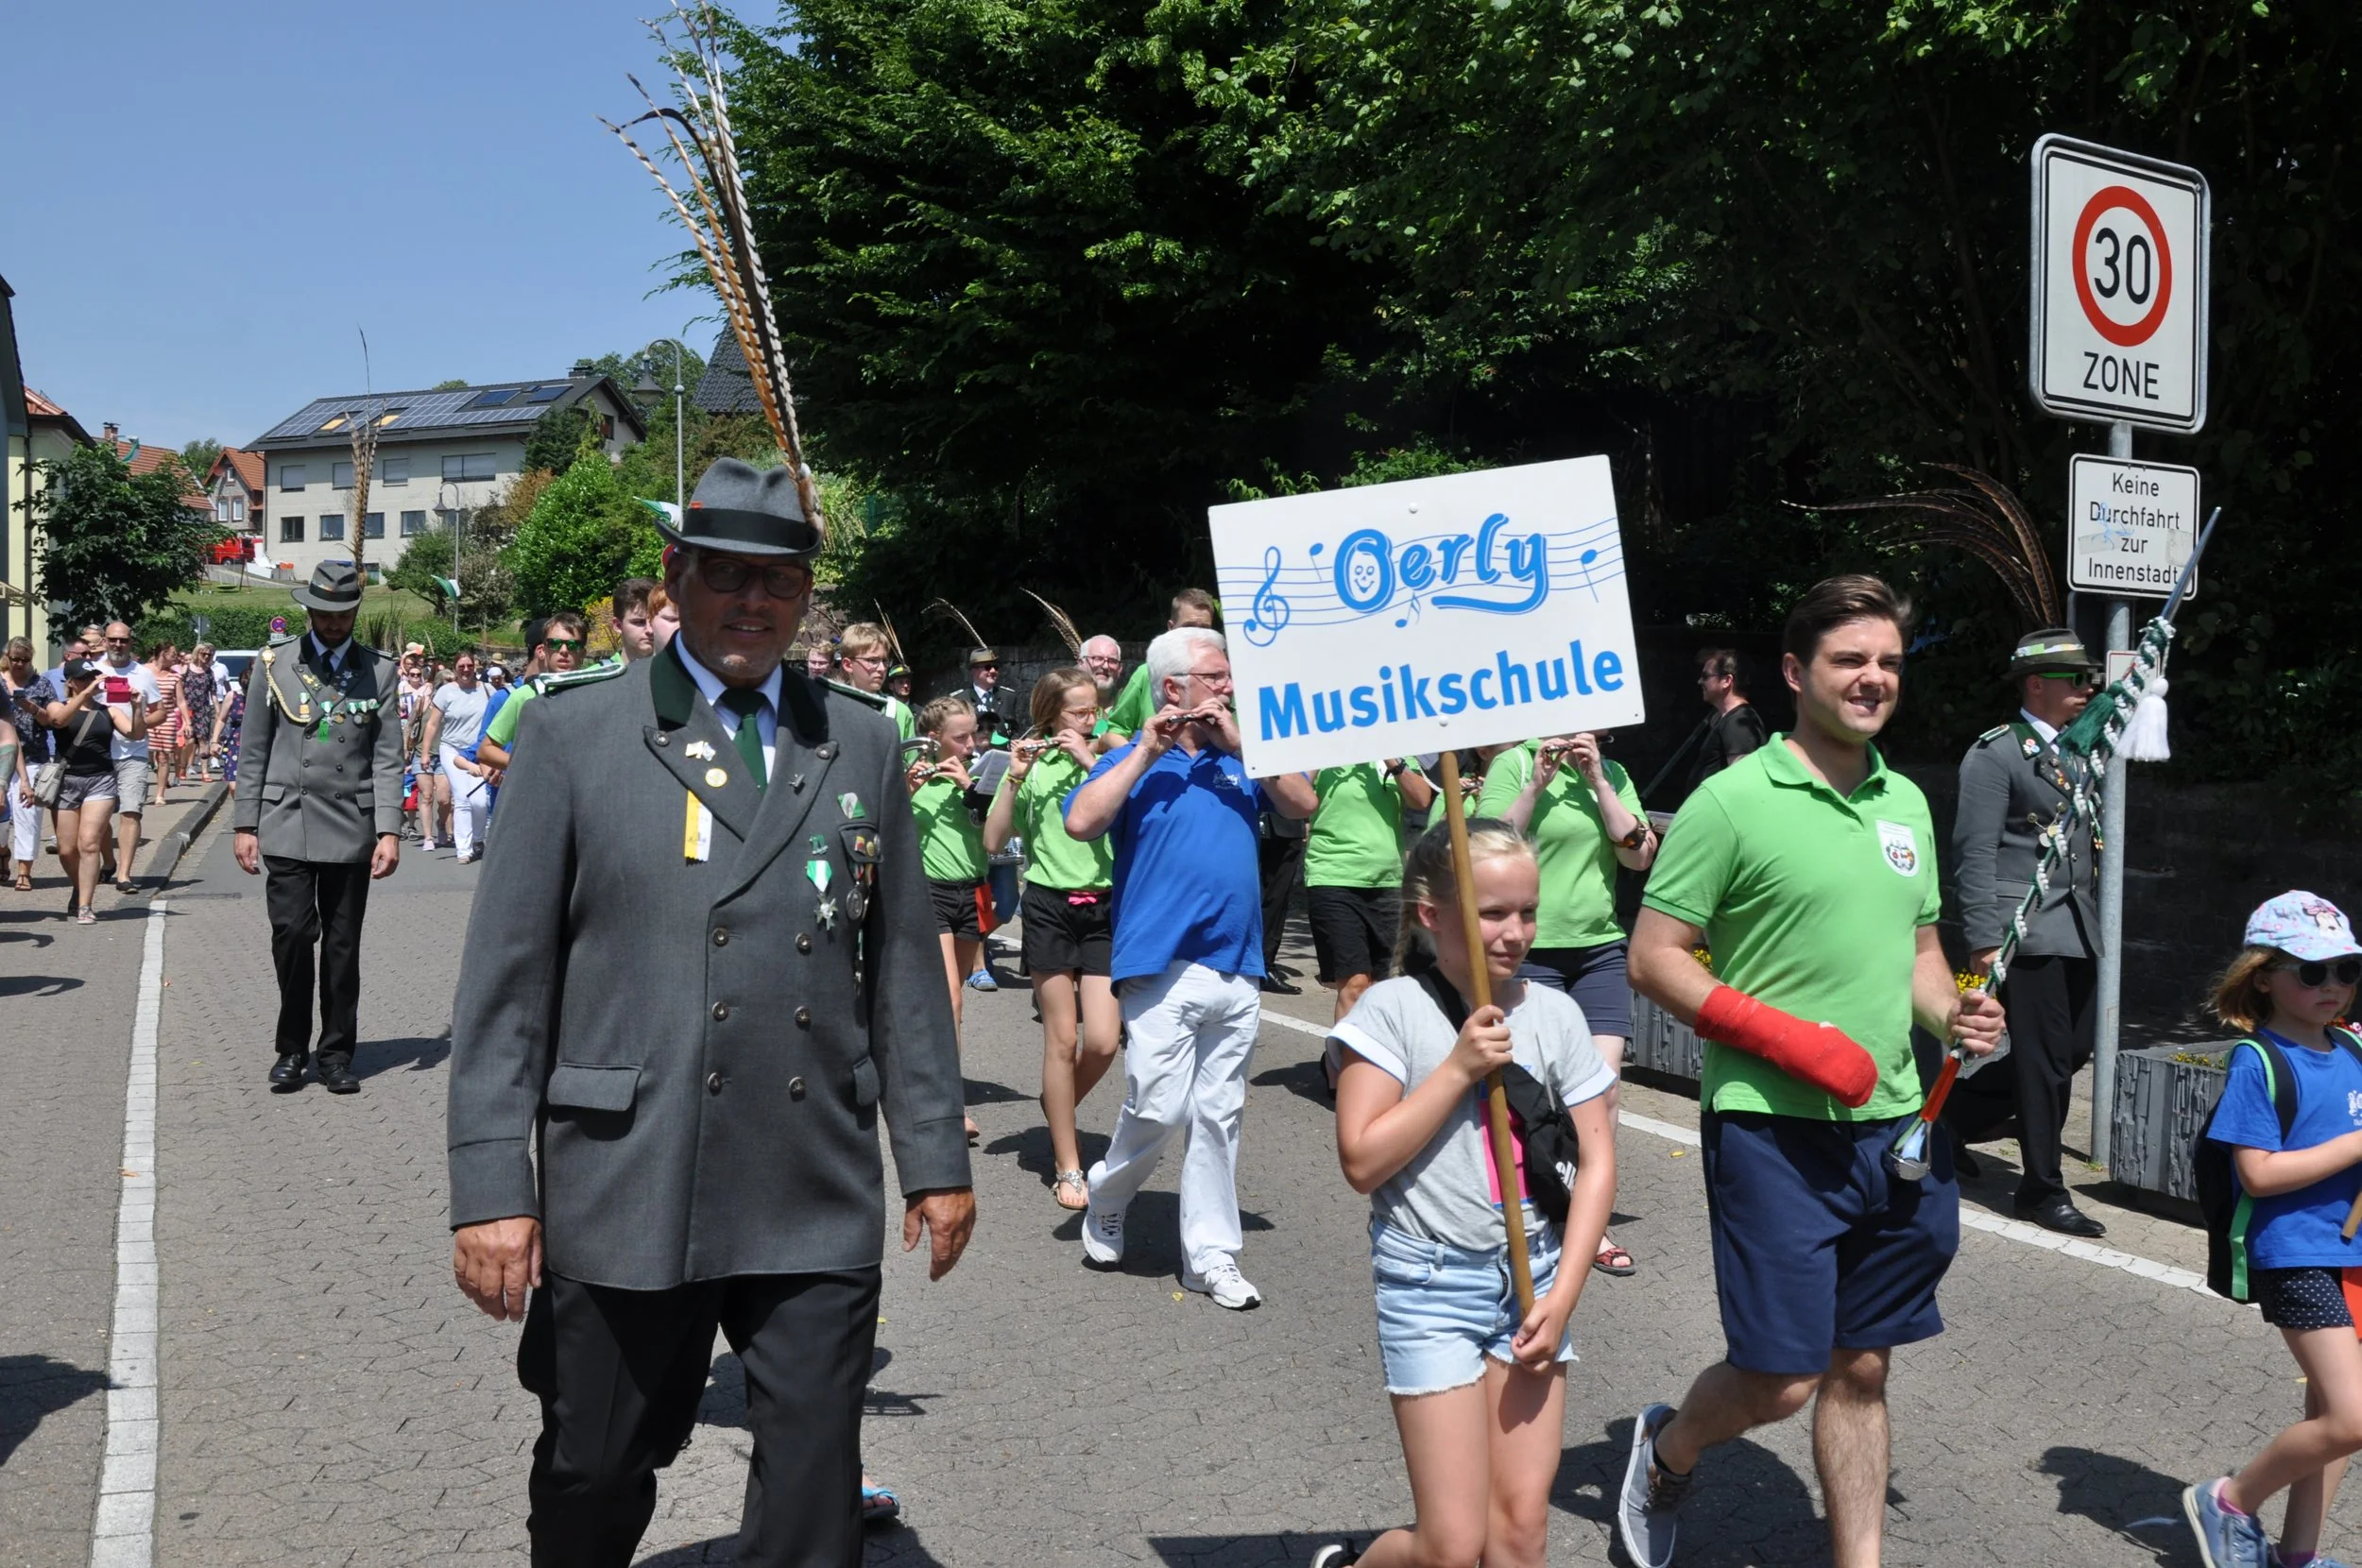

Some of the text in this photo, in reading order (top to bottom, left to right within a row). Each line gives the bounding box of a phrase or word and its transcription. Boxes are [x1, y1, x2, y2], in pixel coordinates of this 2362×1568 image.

[2094, 228, 2151, 305] 30
[2082, 350, 2160, 401] ZONE
[2112, 472, 2160, 497] Keine
[2089, 502, 2181, 530] Durchfahrt
[1334, 512, 1549, 615] Oerly
[2121, 537, 2148, 554] zur
[2088, 557, 2178, 585] Innenstadt
[1258, 639, 1624, 741] Musikschule
